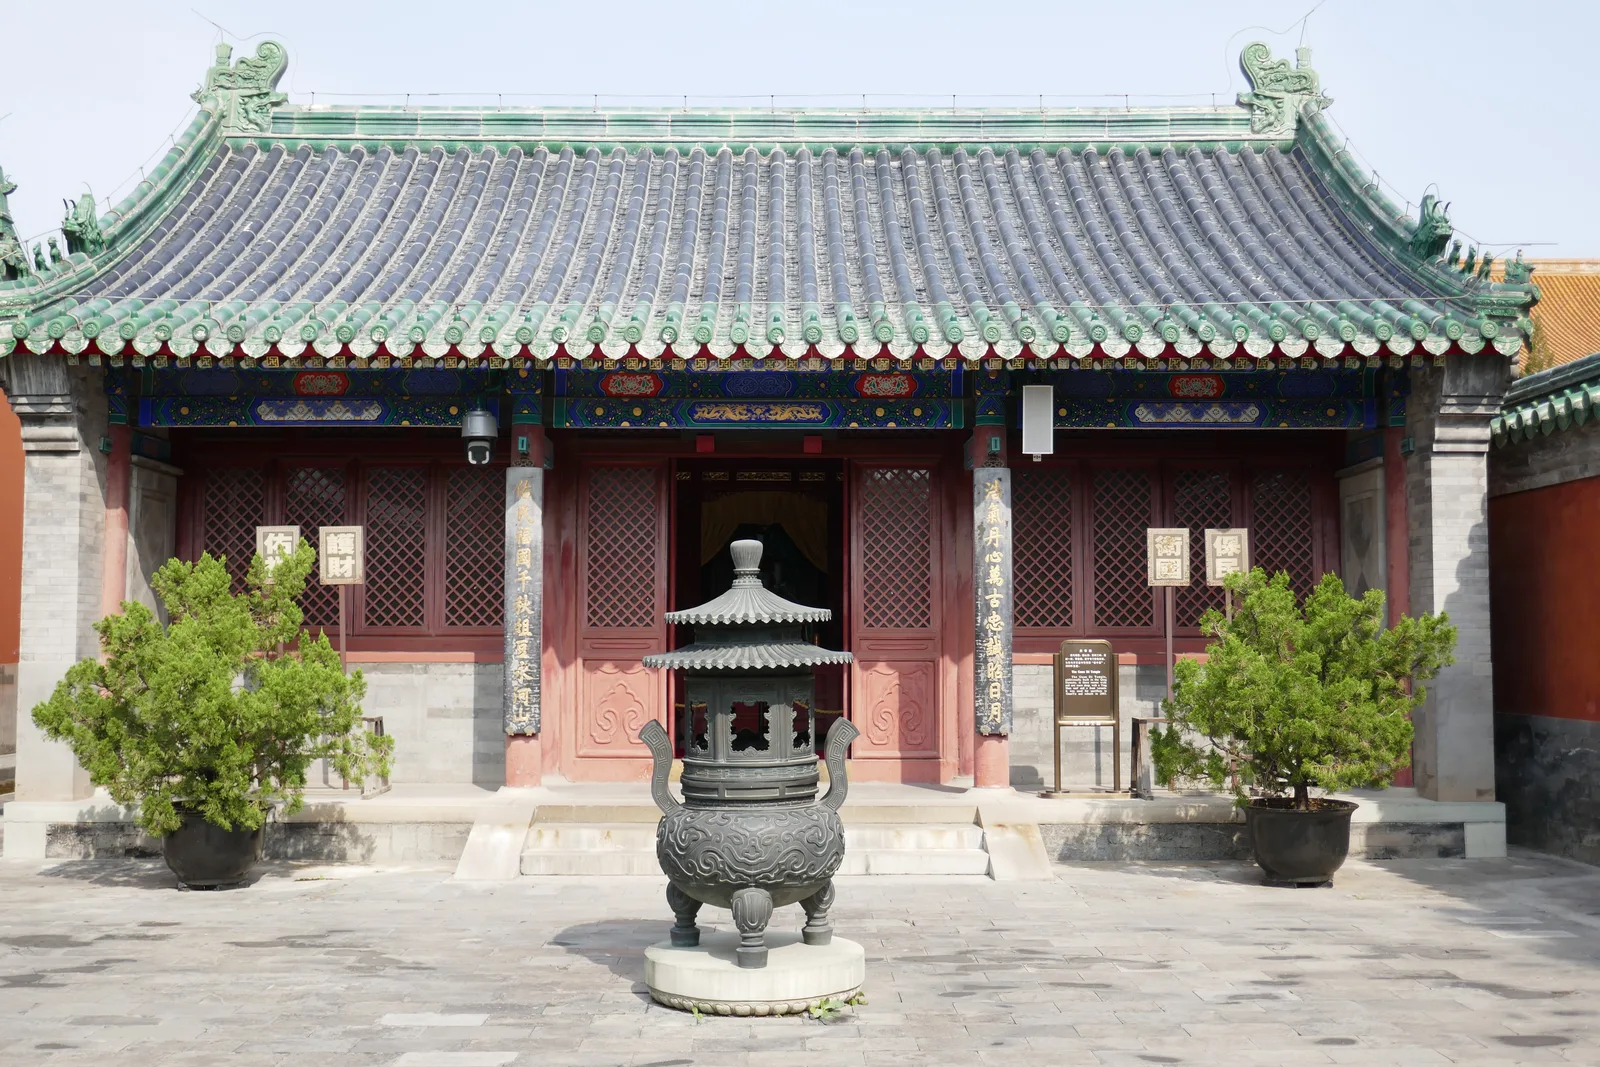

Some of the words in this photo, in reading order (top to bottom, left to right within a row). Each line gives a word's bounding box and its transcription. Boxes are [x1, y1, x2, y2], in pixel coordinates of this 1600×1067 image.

[984, 480, 1005, 725] 浩氣丹心萬古忠誠昭日月
